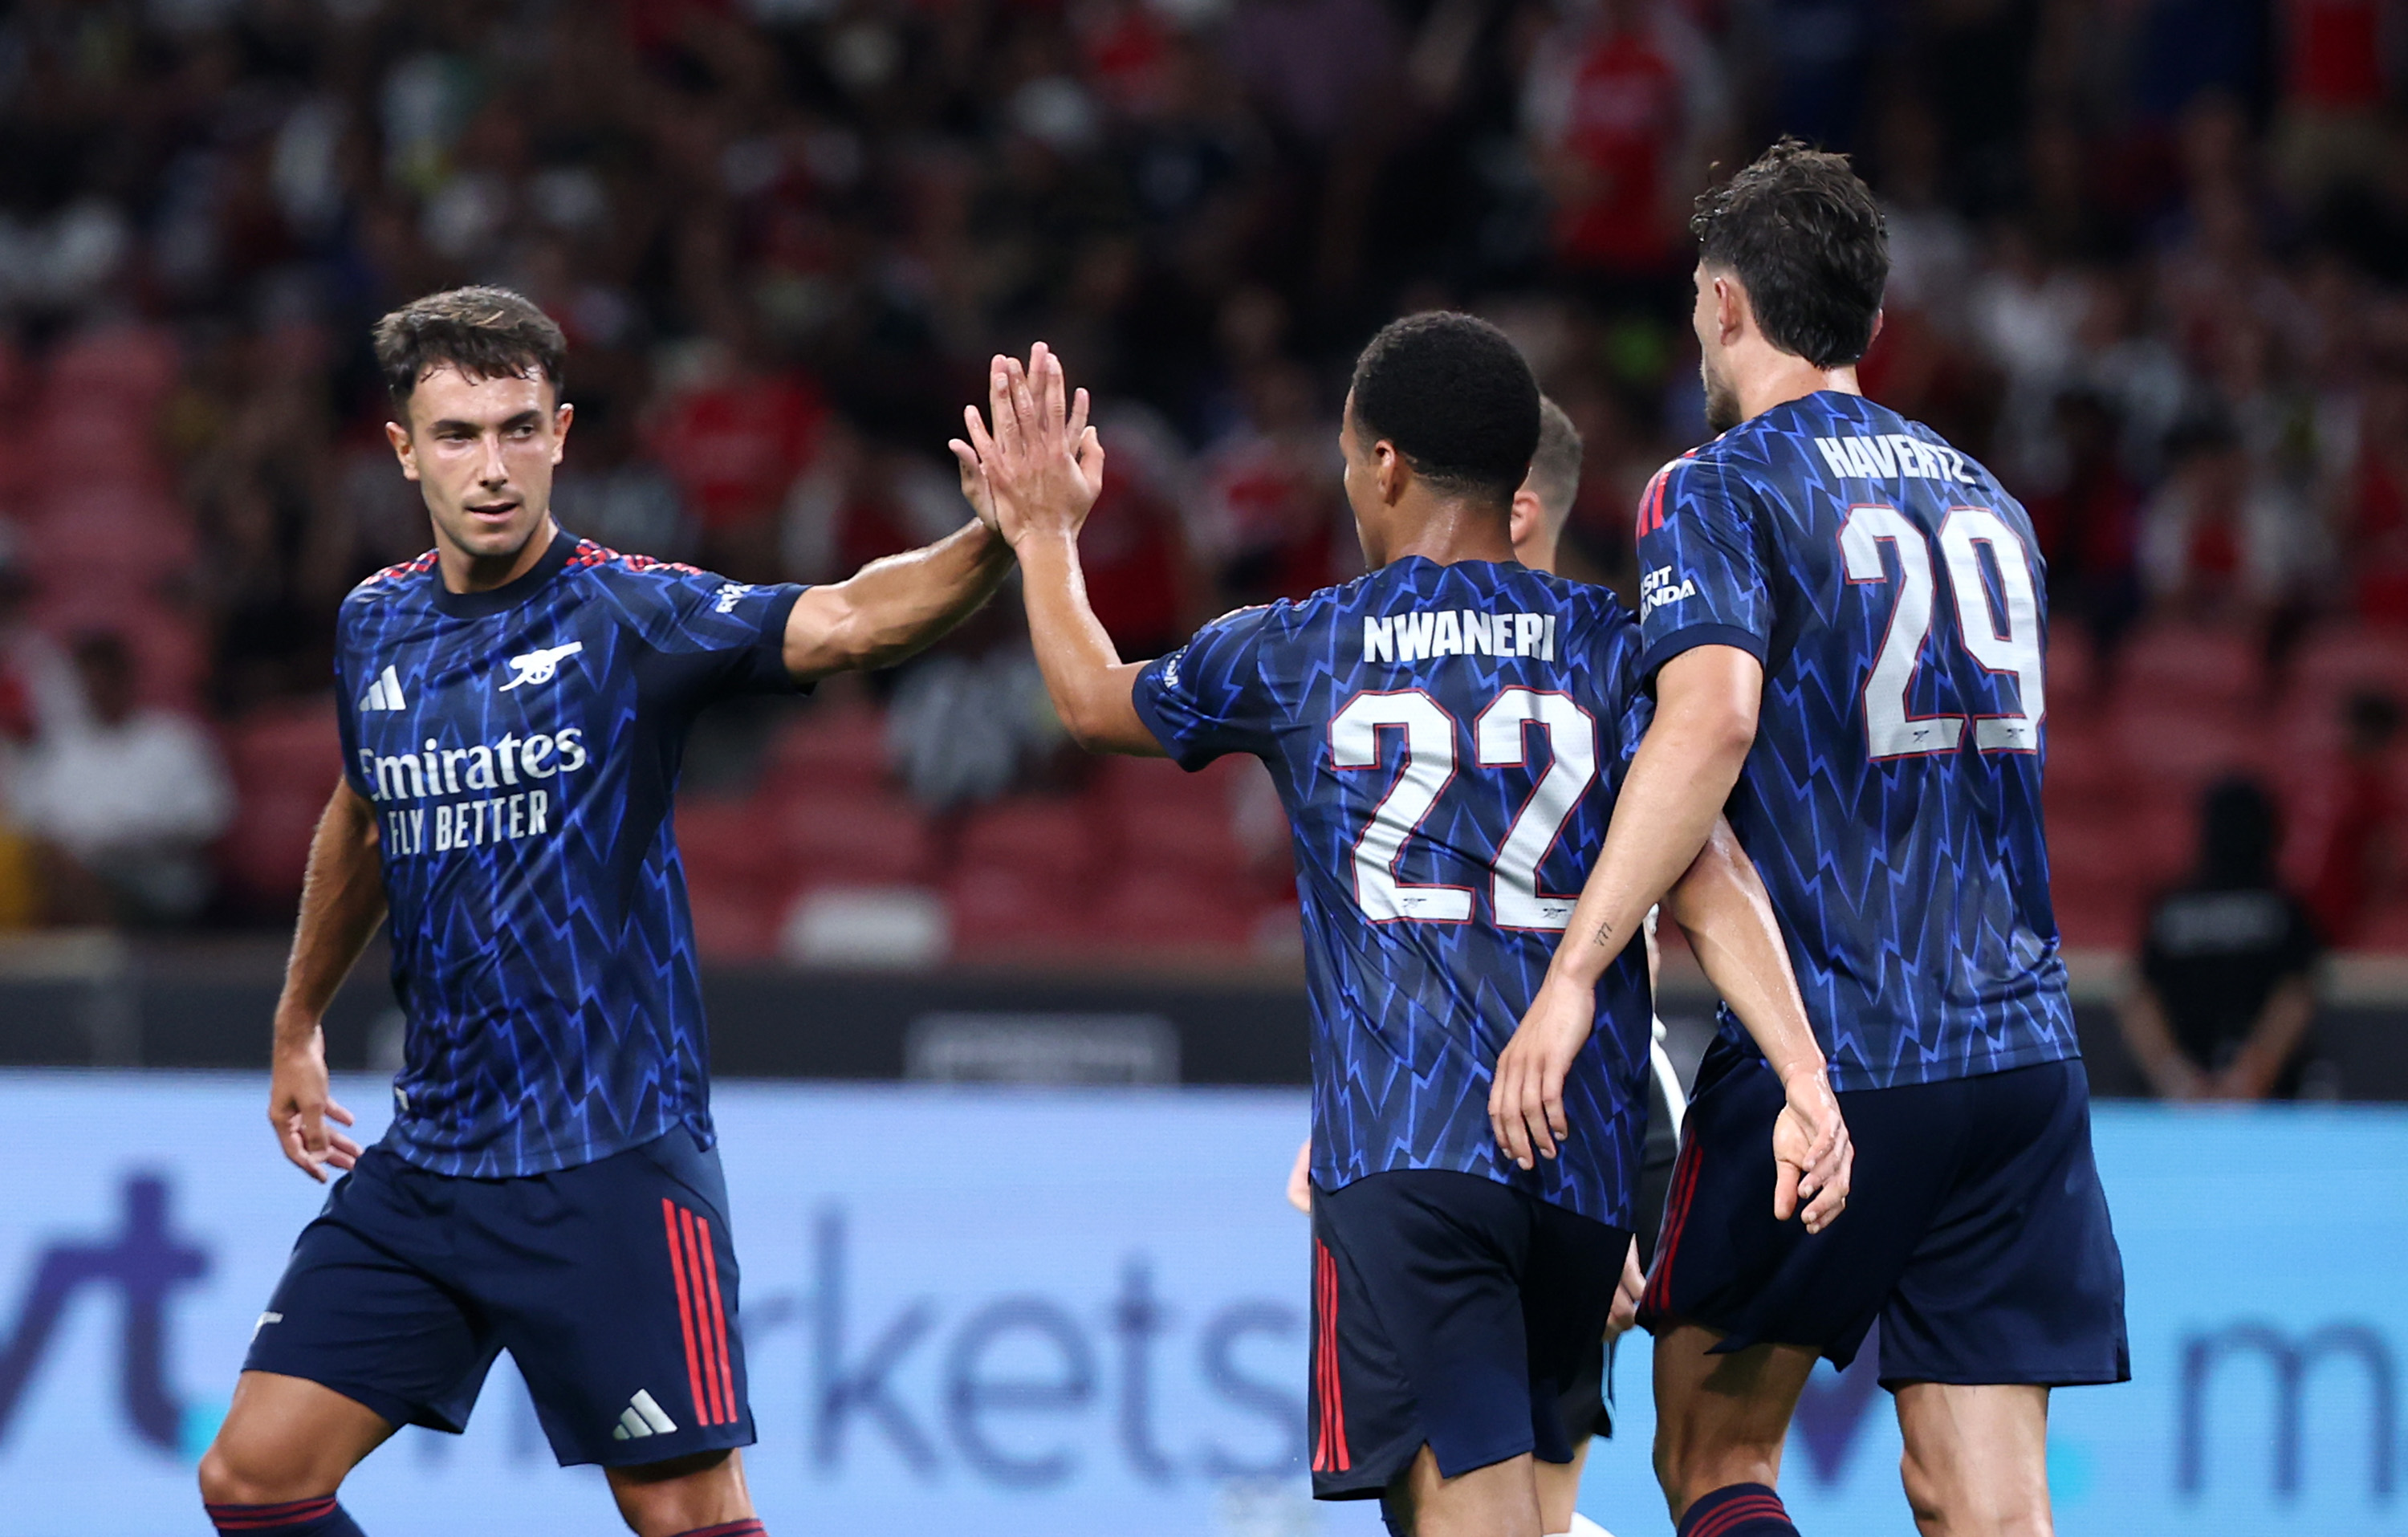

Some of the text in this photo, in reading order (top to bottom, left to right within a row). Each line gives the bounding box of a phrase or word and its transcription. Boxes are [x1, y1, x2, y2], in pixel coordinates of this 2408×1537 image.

[1813, 433, 1976, 485] HAVERTZ
[1363, 609, 1556, 662] NWANERI
[1640, 579, 1696, 626] ANDA
[1838, 503, 2046, 762] 29
[358, 727, 587, 801] Emirates
[387, 789, 548, 856] FLY BETTER
[1328, 685, 1598, 933] 22
